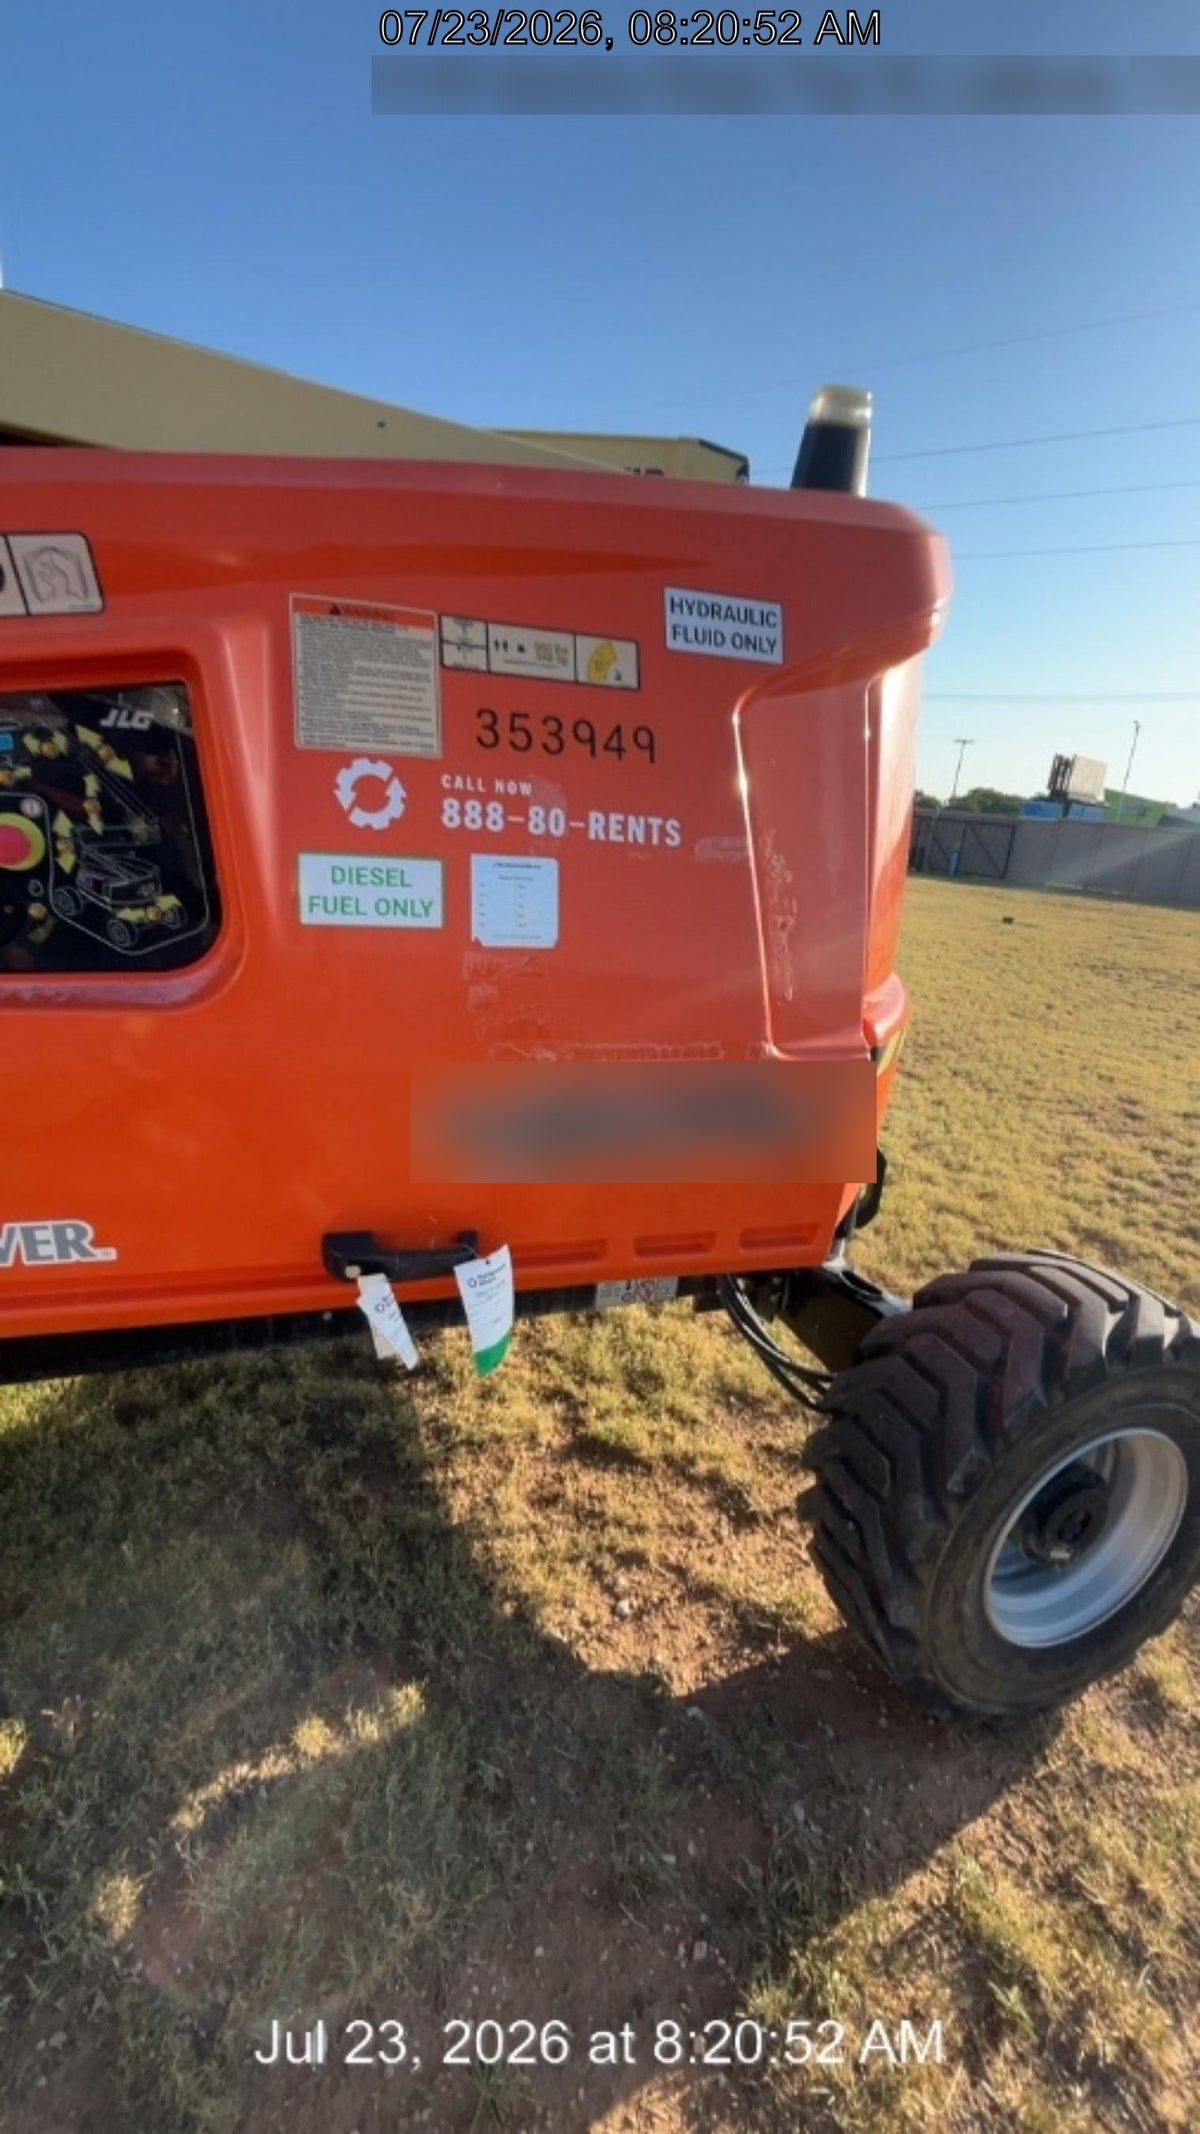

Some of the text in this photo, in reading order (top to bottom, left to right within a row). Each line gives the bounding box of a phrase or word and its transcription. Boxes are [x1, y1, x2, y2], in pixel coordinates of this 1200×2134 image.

[670, 595, 777, 629] HYDRAULIC
[672, 623, 777, 655] FLUID ONLY
[100, 709, 153, 730] JLG
[475, 708, 656, 764] 353949
[440, 773, 532, 796] CALL NOW
[441, 798, 682, 847] 888-80-RENTS
[331, 865, 413, 888] DIESEL
[308, 895, 433, 919] FUEL ONLY
